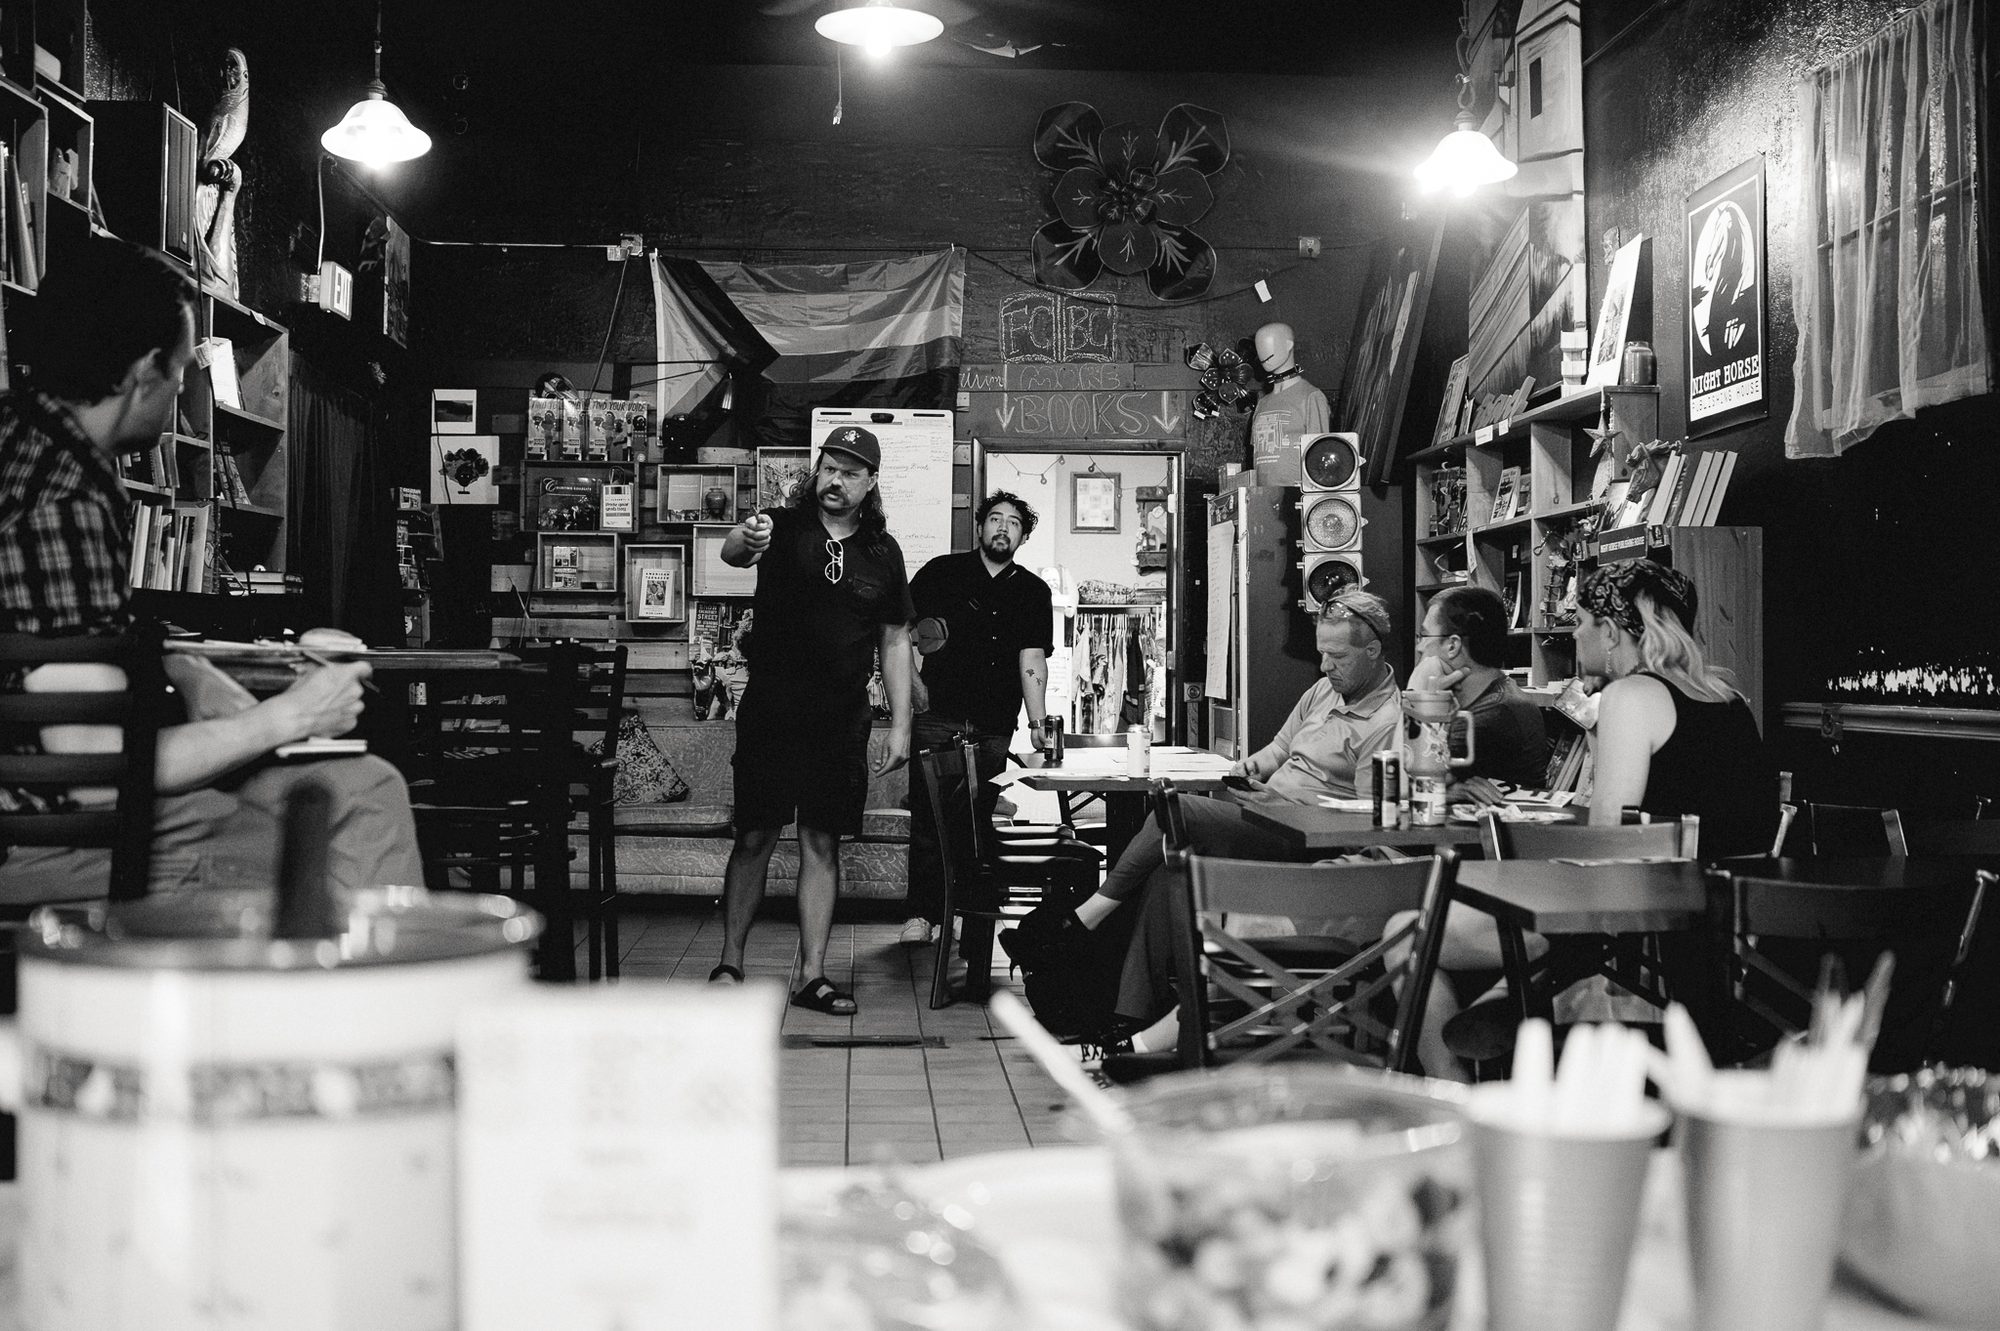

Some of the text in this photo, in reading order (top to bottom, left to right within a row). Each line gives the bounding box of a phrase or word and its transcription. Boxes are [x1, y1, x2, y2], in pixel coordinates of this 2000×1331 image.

[1692, 354, 1759, 396] NIGHT HORSE
[1736, 380, 1759, 398] HOUSE
[609, 401, 626, 412] YOUR
[1013, 391, 1150, 437] BOOKS
